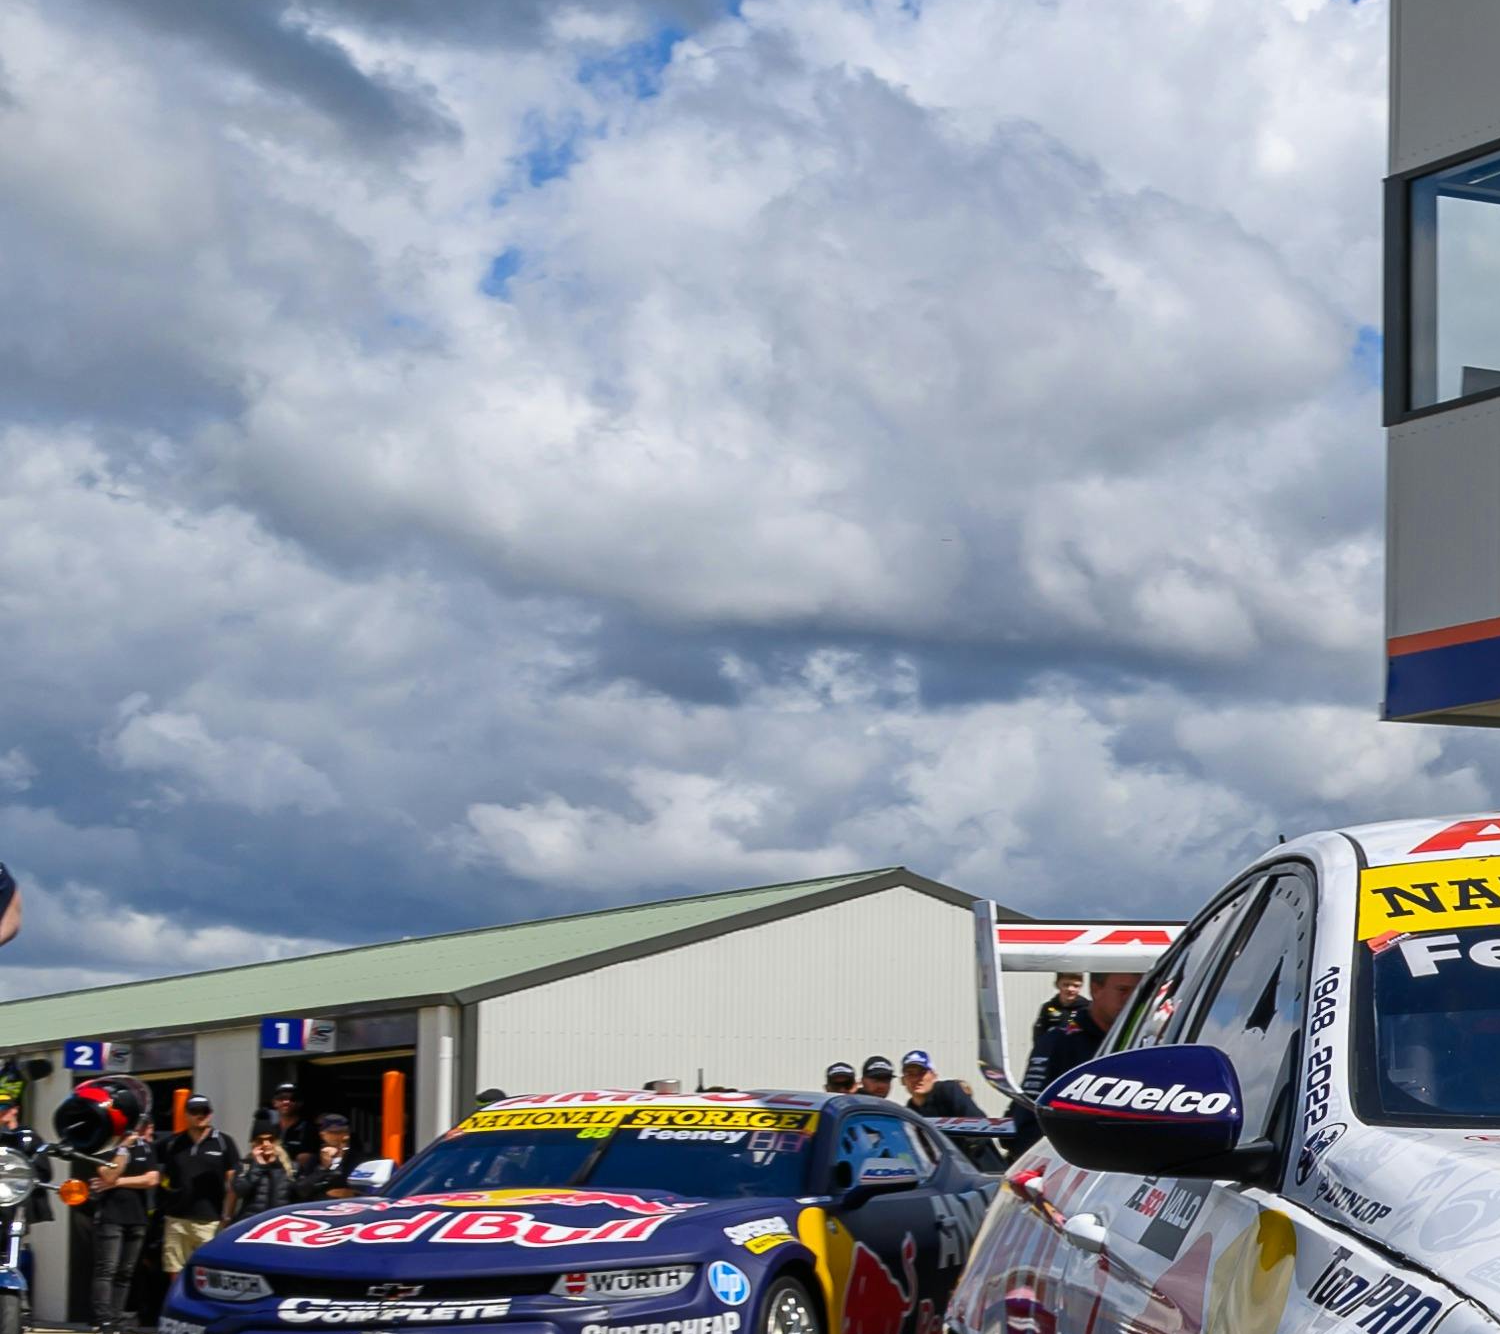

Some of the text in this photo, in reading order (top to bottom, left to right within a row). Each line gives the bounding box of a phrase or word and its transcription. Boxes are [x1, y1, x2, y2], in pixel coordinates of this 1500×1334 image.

[1310, 965, 1341, 1036] 1948
[275, 1022, 290, 1044] 1
[73, 1045, 94, 1066] 2
[1056, 1073, 1232, 1116] ACDelco
[1304, 1045, 1334, 1133] 2022
[632, 1110, 801, 1129] STORAGE
[637, 1127, 749, 1144] Feeney
[1327, 1184, 1393, 1225] DUNLOP
[247, 1212, 666, 1245] Red Bull
